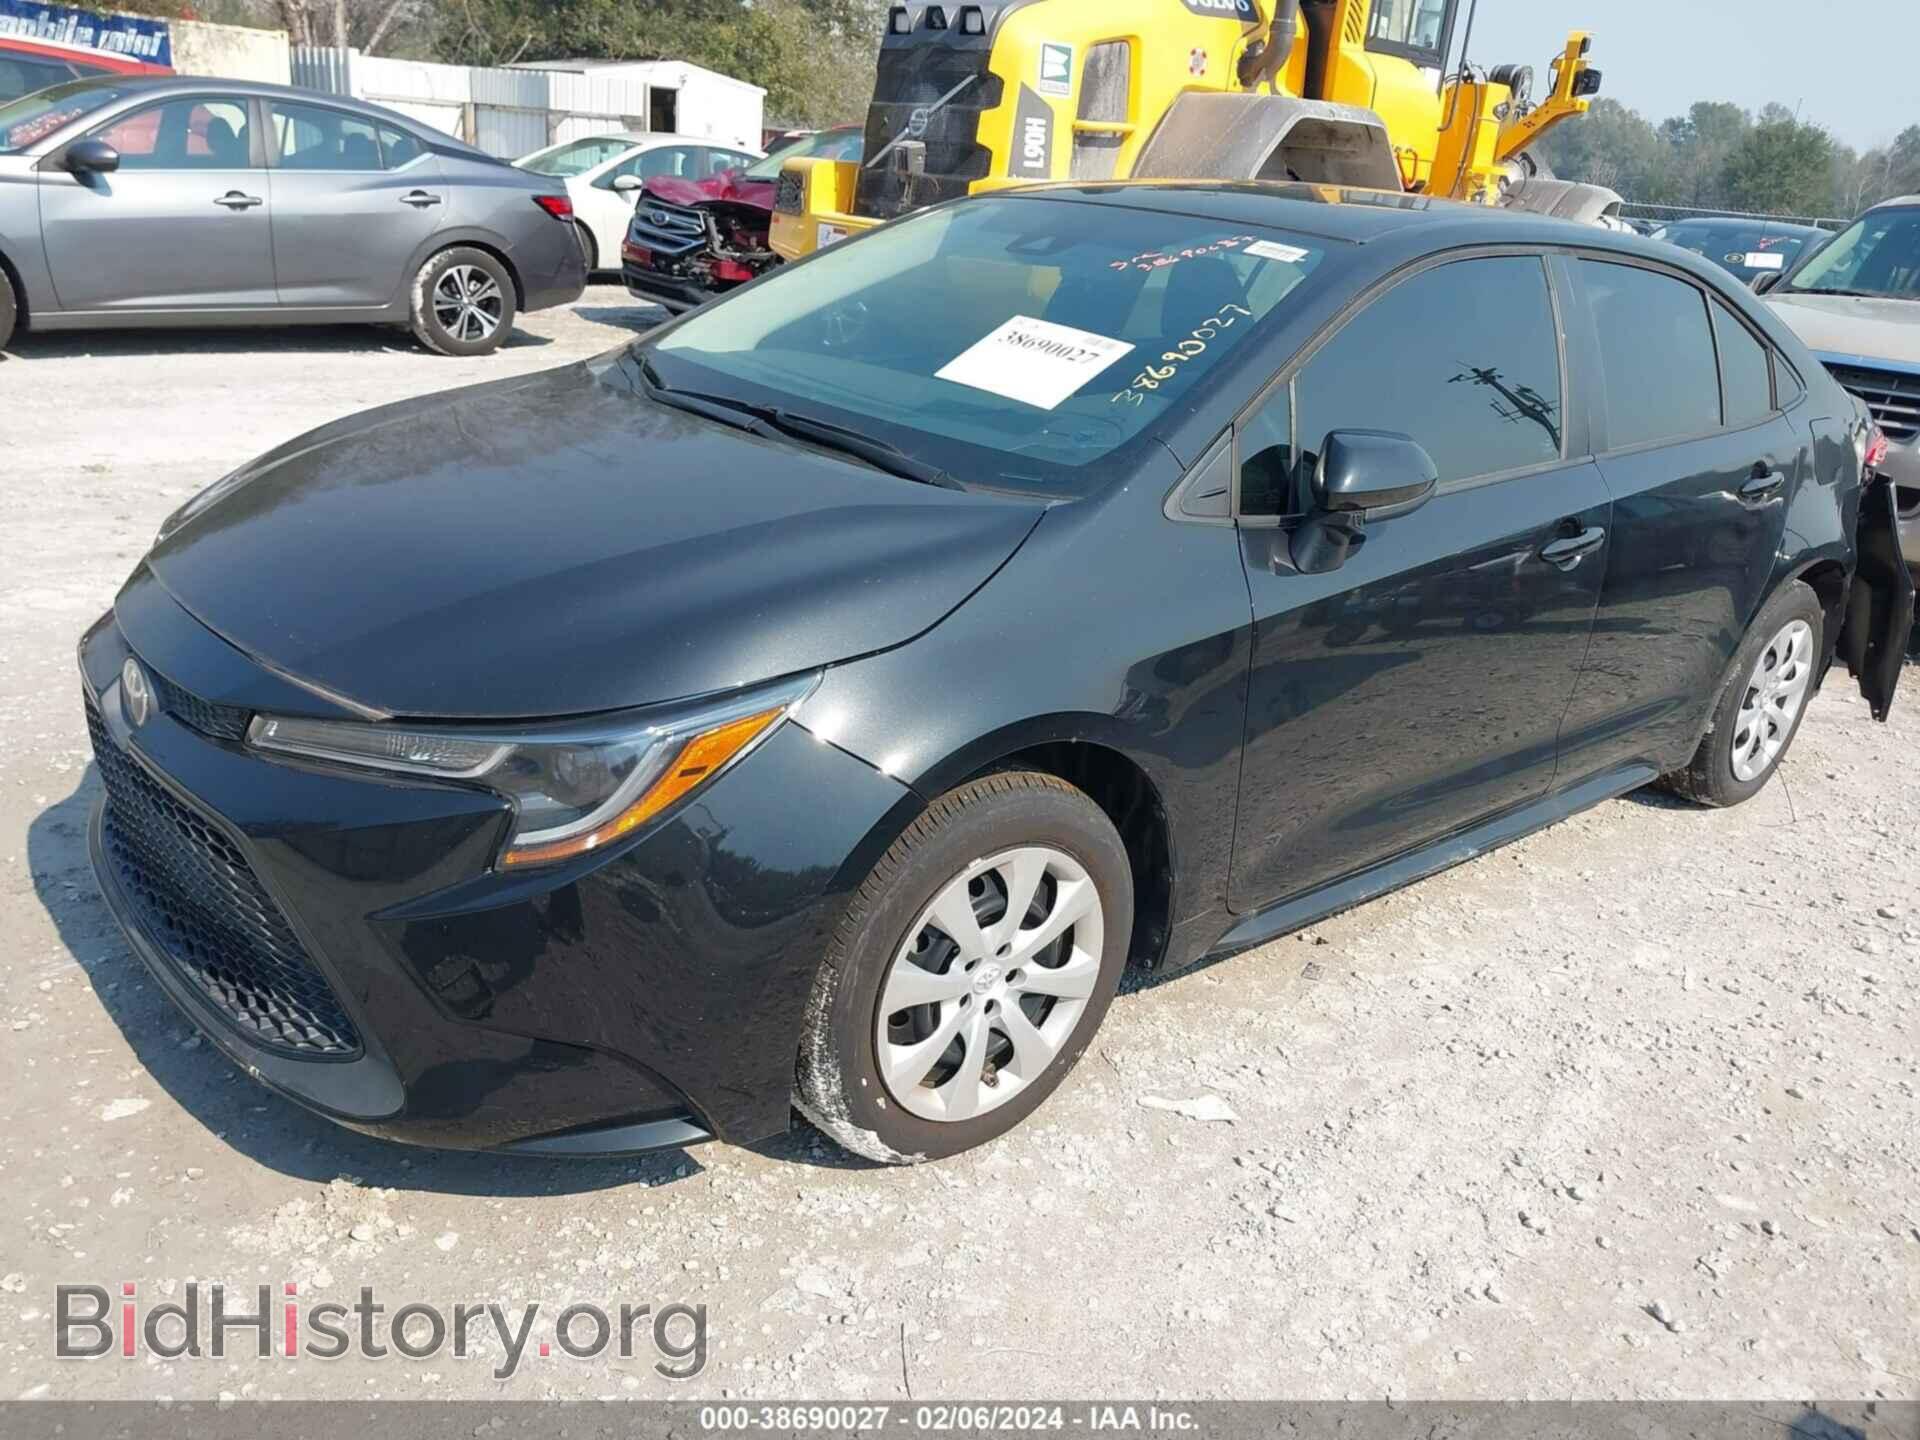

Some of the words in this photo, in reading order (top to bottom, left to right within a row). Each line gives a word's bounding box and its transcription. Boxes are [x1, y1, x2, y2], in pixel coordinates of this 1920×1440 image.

[1023, 116, 1047, 169] L90H
[998, 330, 1101, 365] 38690027
[1110, 303, 1252, 407] 38690027
